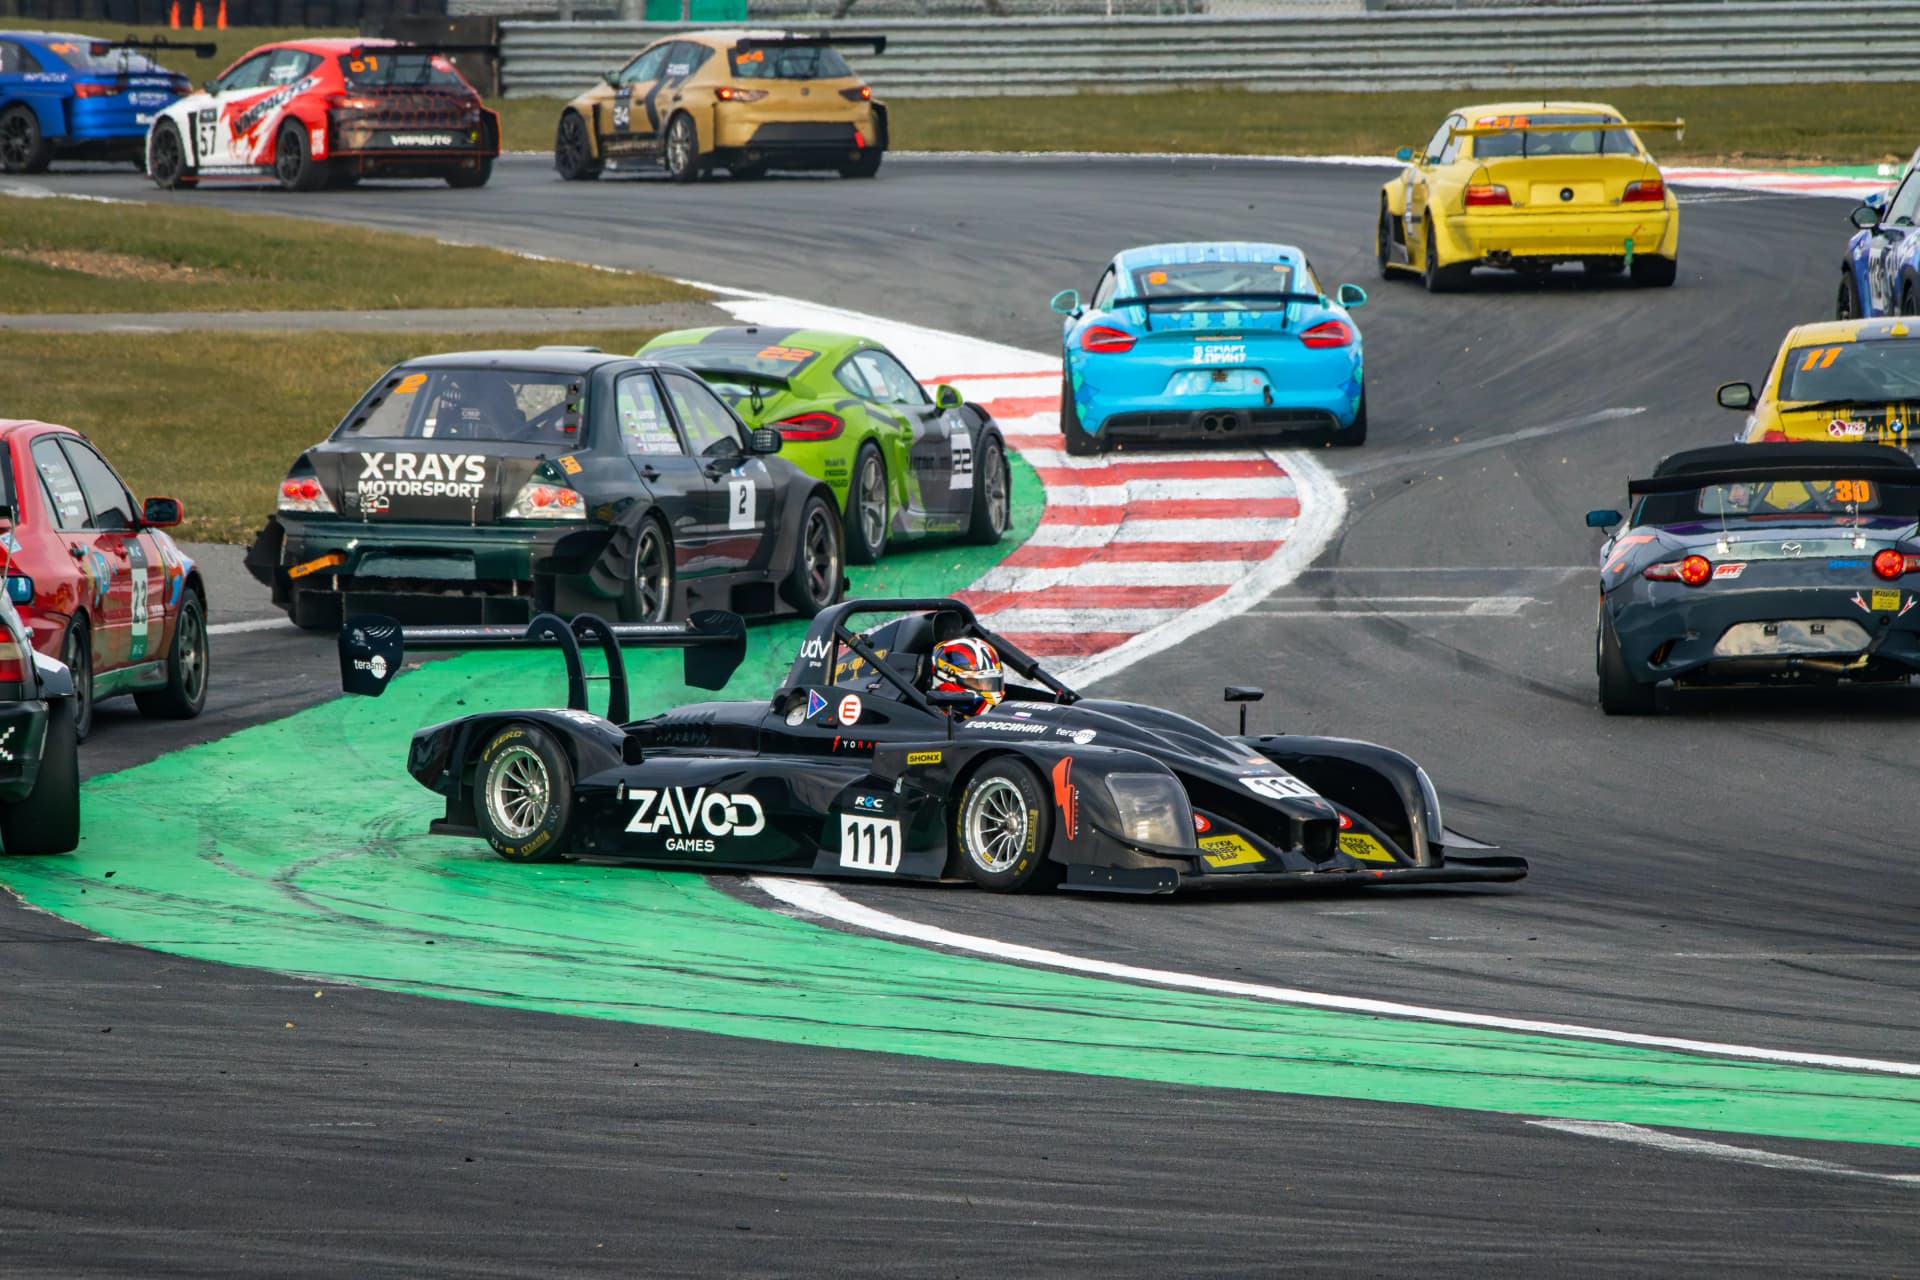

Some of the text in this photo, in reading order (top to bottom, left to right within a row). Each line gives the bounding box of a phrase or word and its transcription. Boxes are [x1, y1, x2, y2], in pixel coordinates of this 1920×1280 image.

[200, 125, 217, 156] 57
[756, 346, 814, 362] 22
[1801, 346, 1843, 371] 11
[393, 374, 427, 393] 2
[360, 452, 486, 482] X-RAYS
[358, 480, 483, 498] MOTORSPORT
[738, 484, 747, 515] 2
[1835, 480, 1869, 502] 30
[908, 752, 941, 764] SHONX
[1253, 778, 1317, 796] 111
[624, 786, 765, 836] ZAVOD
[665, 838, 715, 852] GAMES
[848, 821, 894, 867] 111
